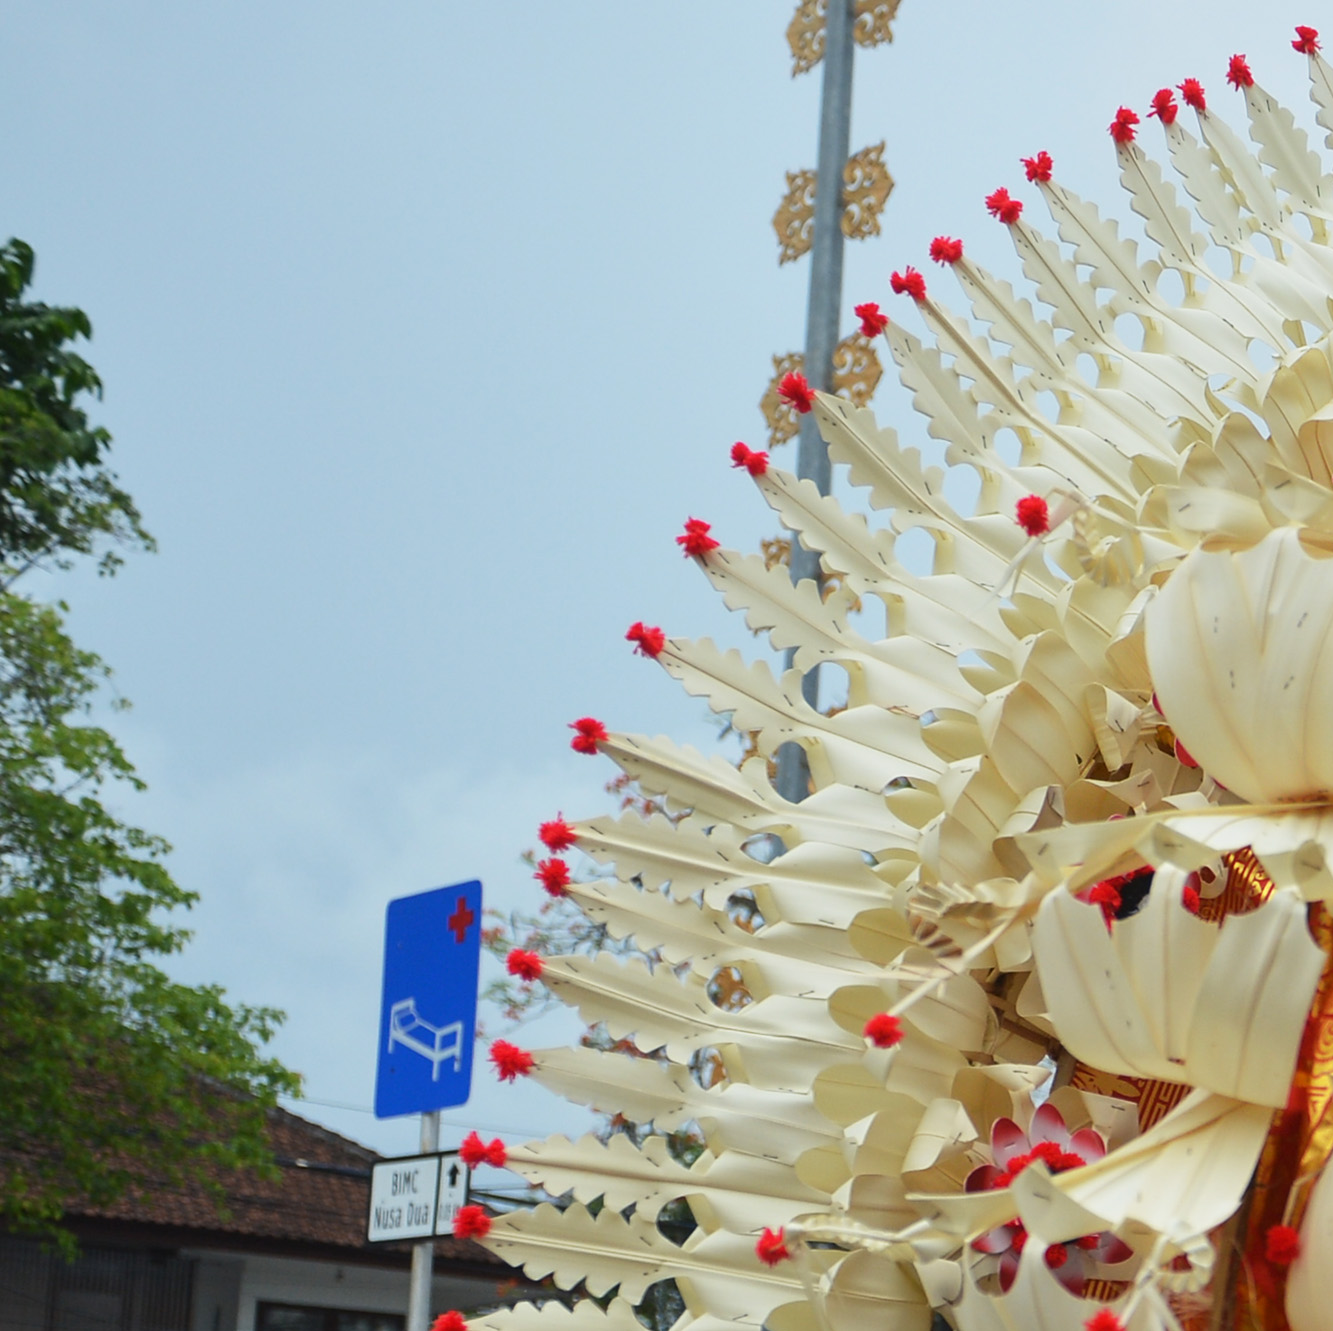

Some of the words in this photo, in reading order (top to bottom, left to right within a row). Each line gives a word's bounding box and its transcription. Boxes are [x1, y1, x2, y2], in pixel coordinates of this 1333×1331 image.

[391, 1168, 419, 1196] BIMC
[374, 1205, 402, 1230] Nusa
[406, 1202, 429, 1227] Dua
